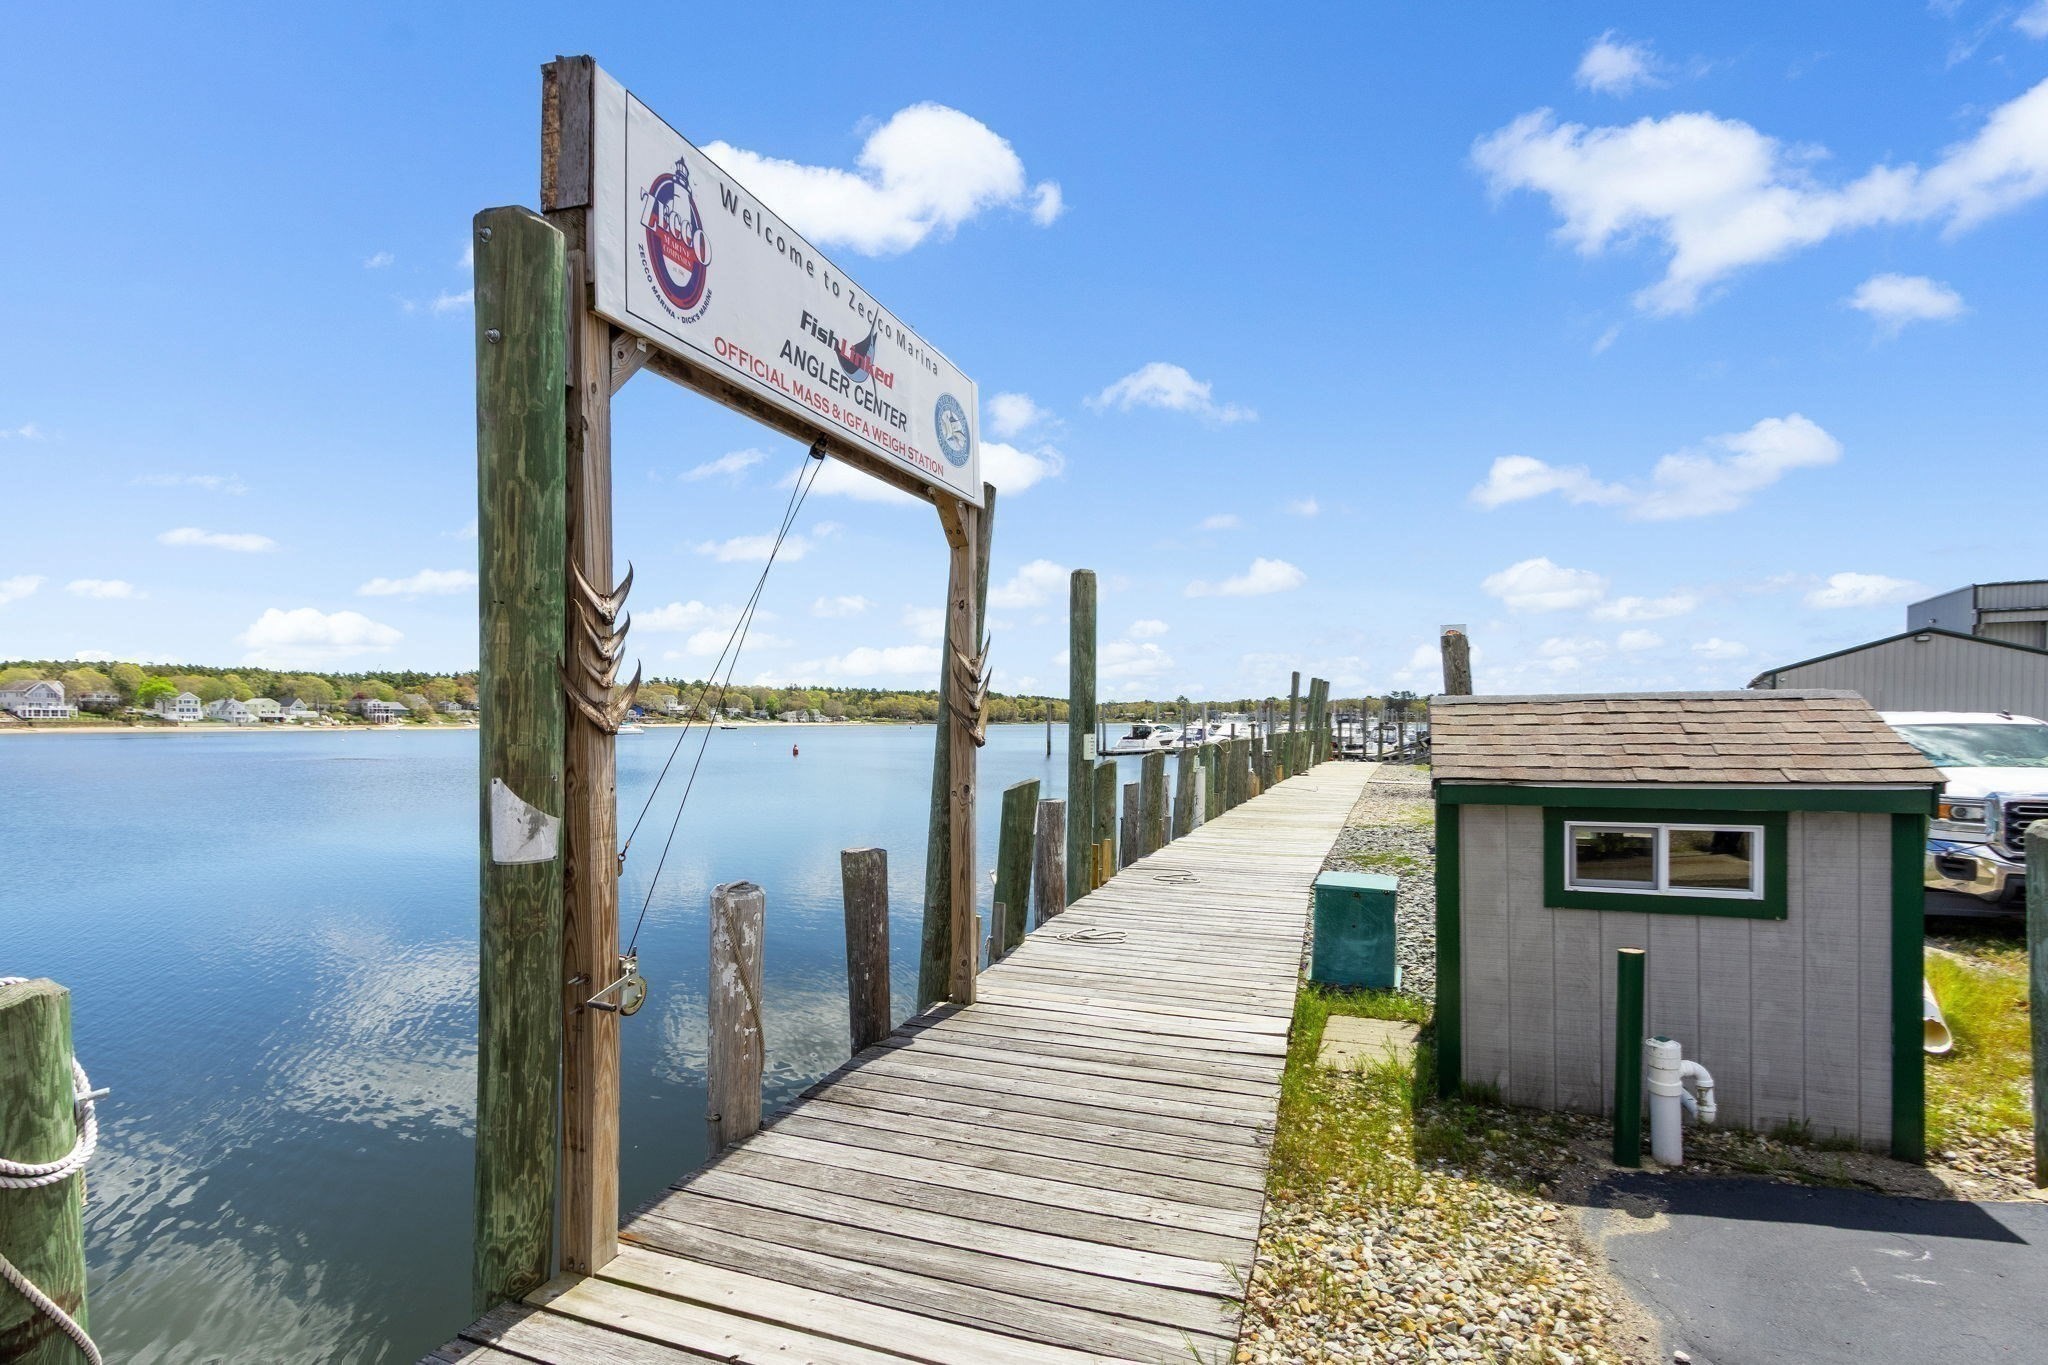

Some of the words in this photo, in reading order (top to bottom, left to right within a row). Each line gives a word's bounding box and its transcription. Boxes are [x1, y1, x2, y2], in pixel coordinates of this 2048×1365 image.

[640, 186, 712, 267] ZECCO
[663, 234, 691, 258] MARINE
[638, 242, 653, 283] ZECCO
[651, 285, 676, 320] MARINA
[681, 310, 701, 324] DICK'S
[698, 288, 713, 316] MARINE
[720, 182, 814, 277] Welcome
[824, 271, 840, 297] to
[848, 289, 892, 338] Zecco
[896, 329, 938, 376] Marina
[780, 339, 850, 398] ANGLER
[854, 385, 907, 432] CENTER
[800, 310, 894, 389] FishLinked
[714, 336, 789, 393] OFFICIAL
[793, 380, 830, 414] MASS
[832, 403, 841, 421] &
[843, 409, 870, 437] IGFA
[872, 425, 906, 457] WEIGH
[908, 446, 944, 477] STATION
